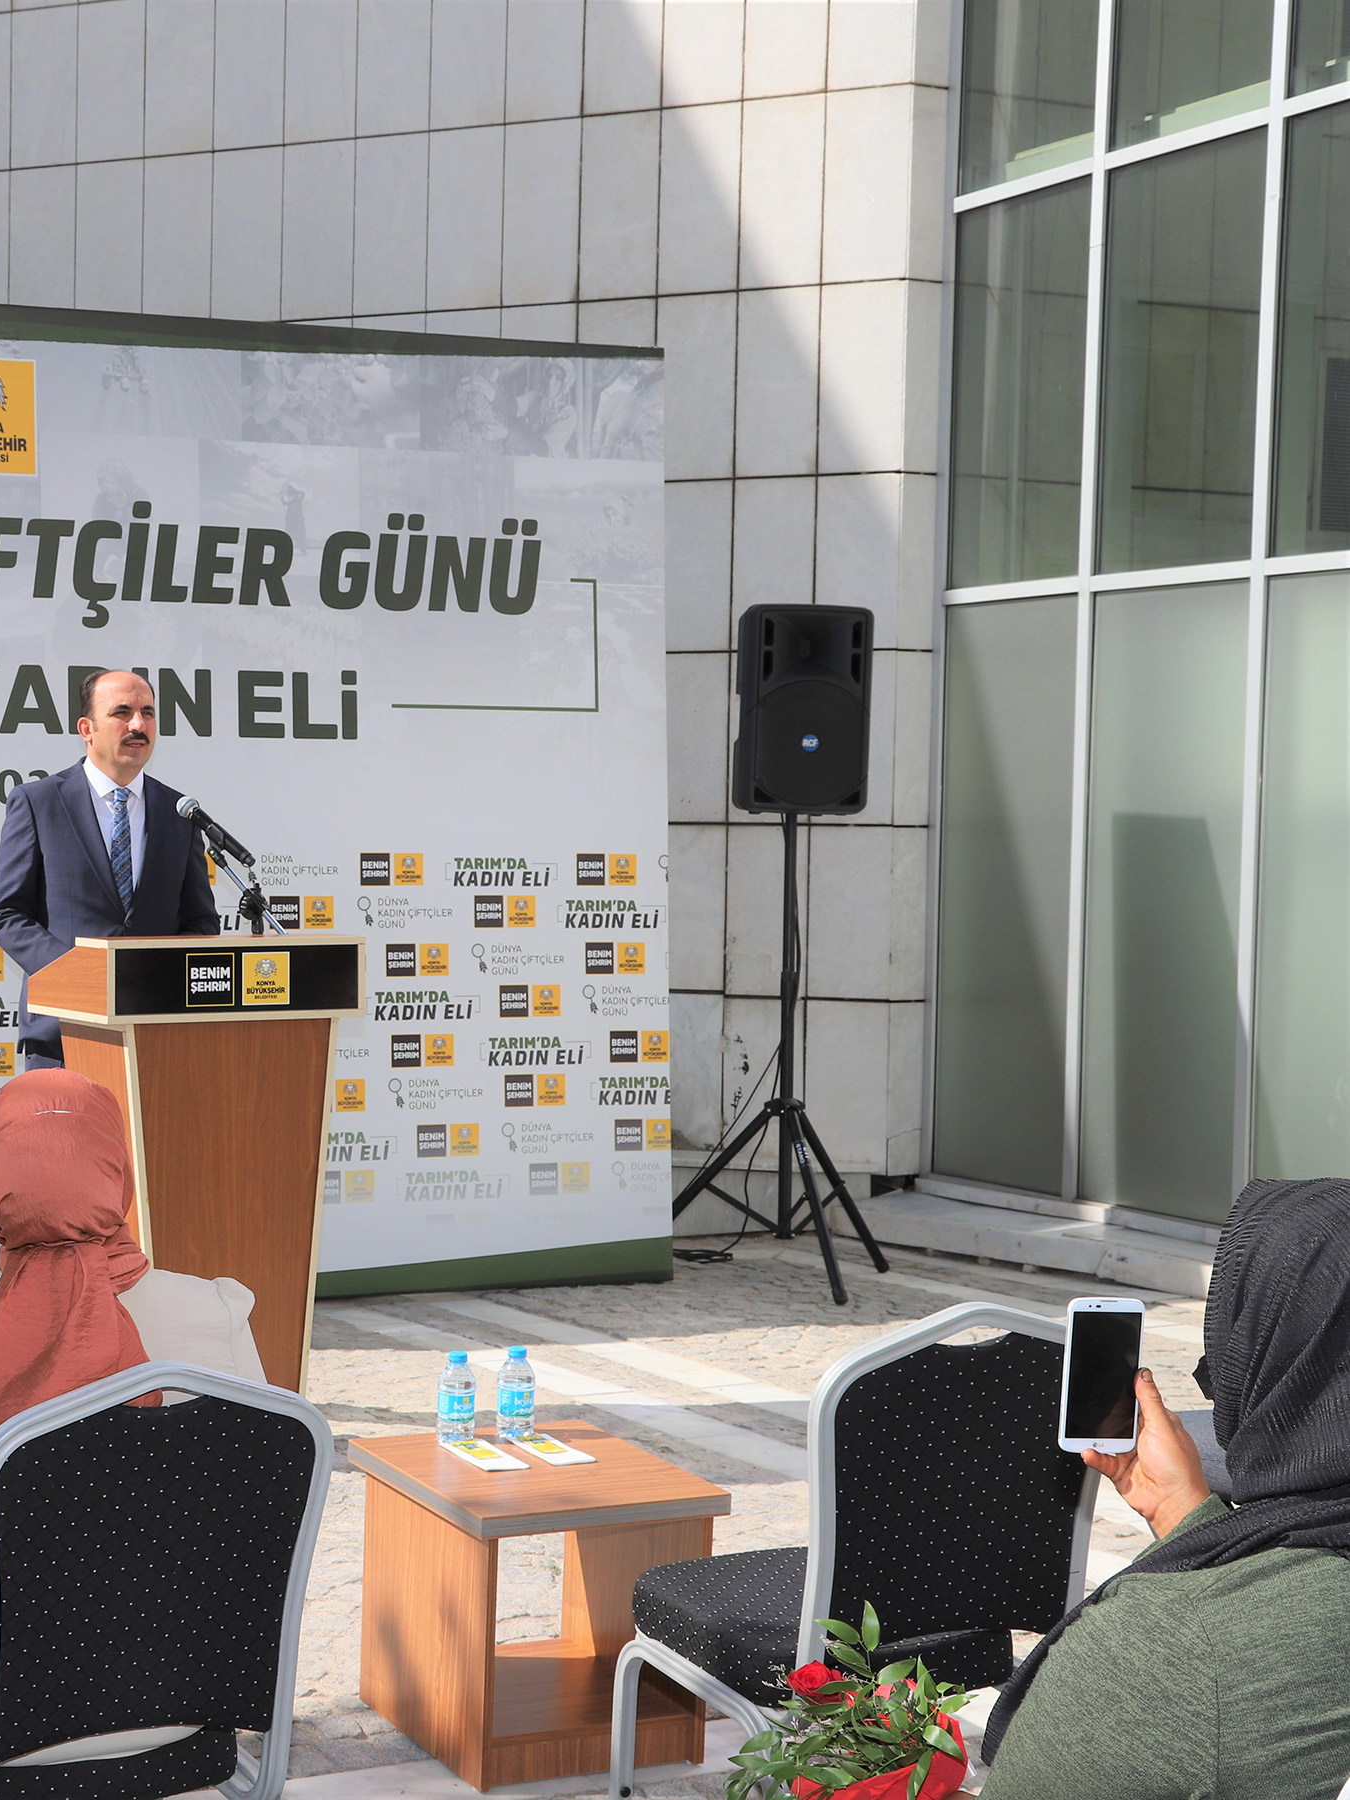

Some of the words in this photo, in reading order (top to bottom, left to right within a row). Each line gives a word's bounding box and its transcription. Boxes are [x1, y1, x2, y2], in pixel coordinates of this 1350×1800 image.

[319, 513, 542, 615] GÜNÜ
[803, 738, 818, 747] RCF
[454, 857, 528, 870] TARIM'DA
[453, 871, 515, 887] KADIN
[377, 896, 409, 907] DÜNYA
[565, 900, 637, 912] TARIM'DA
[378, 909, 405, 918] KADIN
[407, 907, 453, 919] ÇİFTÇİLER
[377, 918, 406, 929] GÜNÜ
[565, 913, 625, 929] KADIN
[491, 943, 522, 954] DÜNYA
[491, 955, 518, 964] KADIN
[520, 954, 565, 966] ÇİFTÇİLER
[491, 965, 518, 976] GÜNÜ
[375, 990, 450, 1004] TARIM'DA
[374, 1004, 437, 1021] KADIN
[488, 1036, 562, 1050] TARIM'DA
[488, 1050, 549, 1067] KADIN
[408, 1077, 440, 1088] DÜNYA
[599, 1076, 670, 1089] TARIM'DA
[408, 1090, 436, 1099] KADIN
[438, 1087, 483, 1100] ÇİFTÇİLER
[598, 1090, 657, 1106] KADIN
[408, 1099, 436, 1110] GÜNÜ
